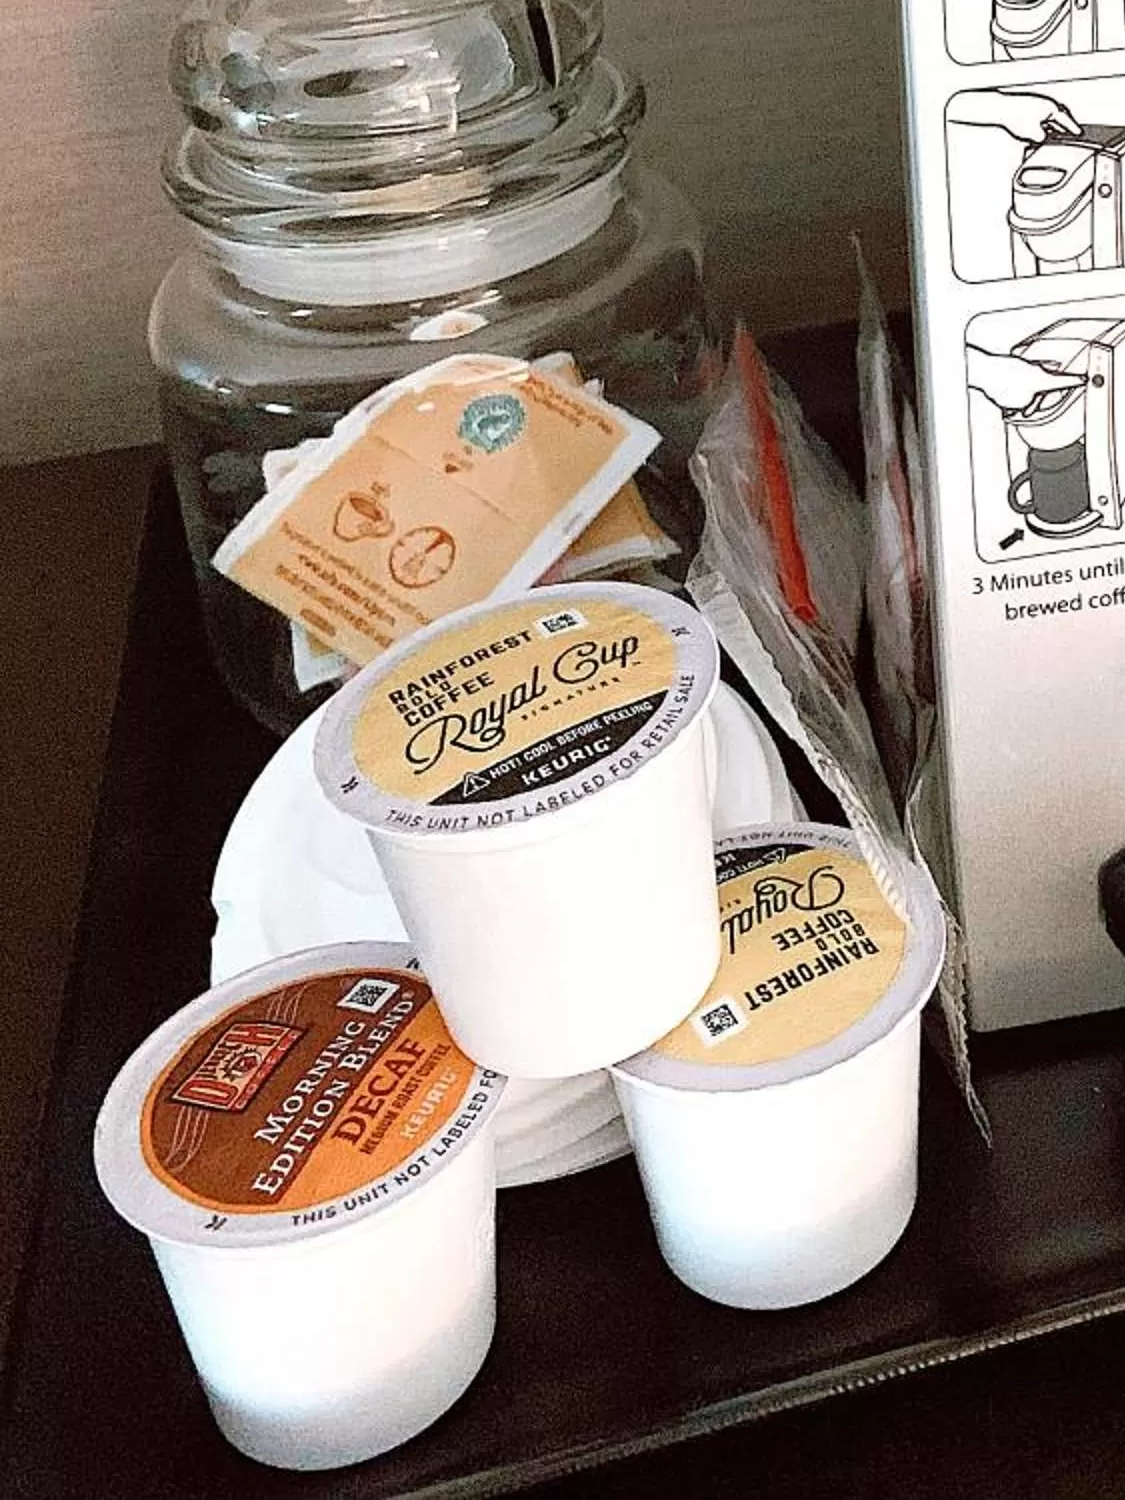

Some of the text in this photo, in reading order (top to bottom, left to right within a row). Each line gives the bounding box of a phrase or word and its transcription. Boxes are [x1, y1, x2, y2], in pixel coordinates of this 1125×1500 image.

[971, 577, 985, 595] 3
[990, 567, 1074, 593] Minutes
[1079, 558, 1125, 582] until
[1004, 592, 1083, 621] brewed
[388, 630, 532, 705] RAINFOREST
[403, 671, 495, 727] COFFEE
[405, 634, 640, 775] Royal Cup
[384, 674, 695, 831] THIS UNIT NOT LABELED FOR RETAIL SALE
[488, 700, 654, 781] HOT! COOL BEFORE PEELING
[521, 742, 609, 788] KEURIG
[719, 865, 845, 955] Royal
[771, 908, 856, 952] COFFEE
[814, 922, 866, 952] BOLD
[743, 936, 881, 1011] RAINFOREST
[253, 1019, 366, 1145] MORNING
[331, 1037, 426, 1147] DECAF
[251, 1078, 351, 1196] EDITION
[291, 1204, 338, 1228] THIS
[344, 1182, 390, 1211] UNIT
[393, 1154, 431, 1187] NOT
[431, 1092, 489, 1157] LABELED
